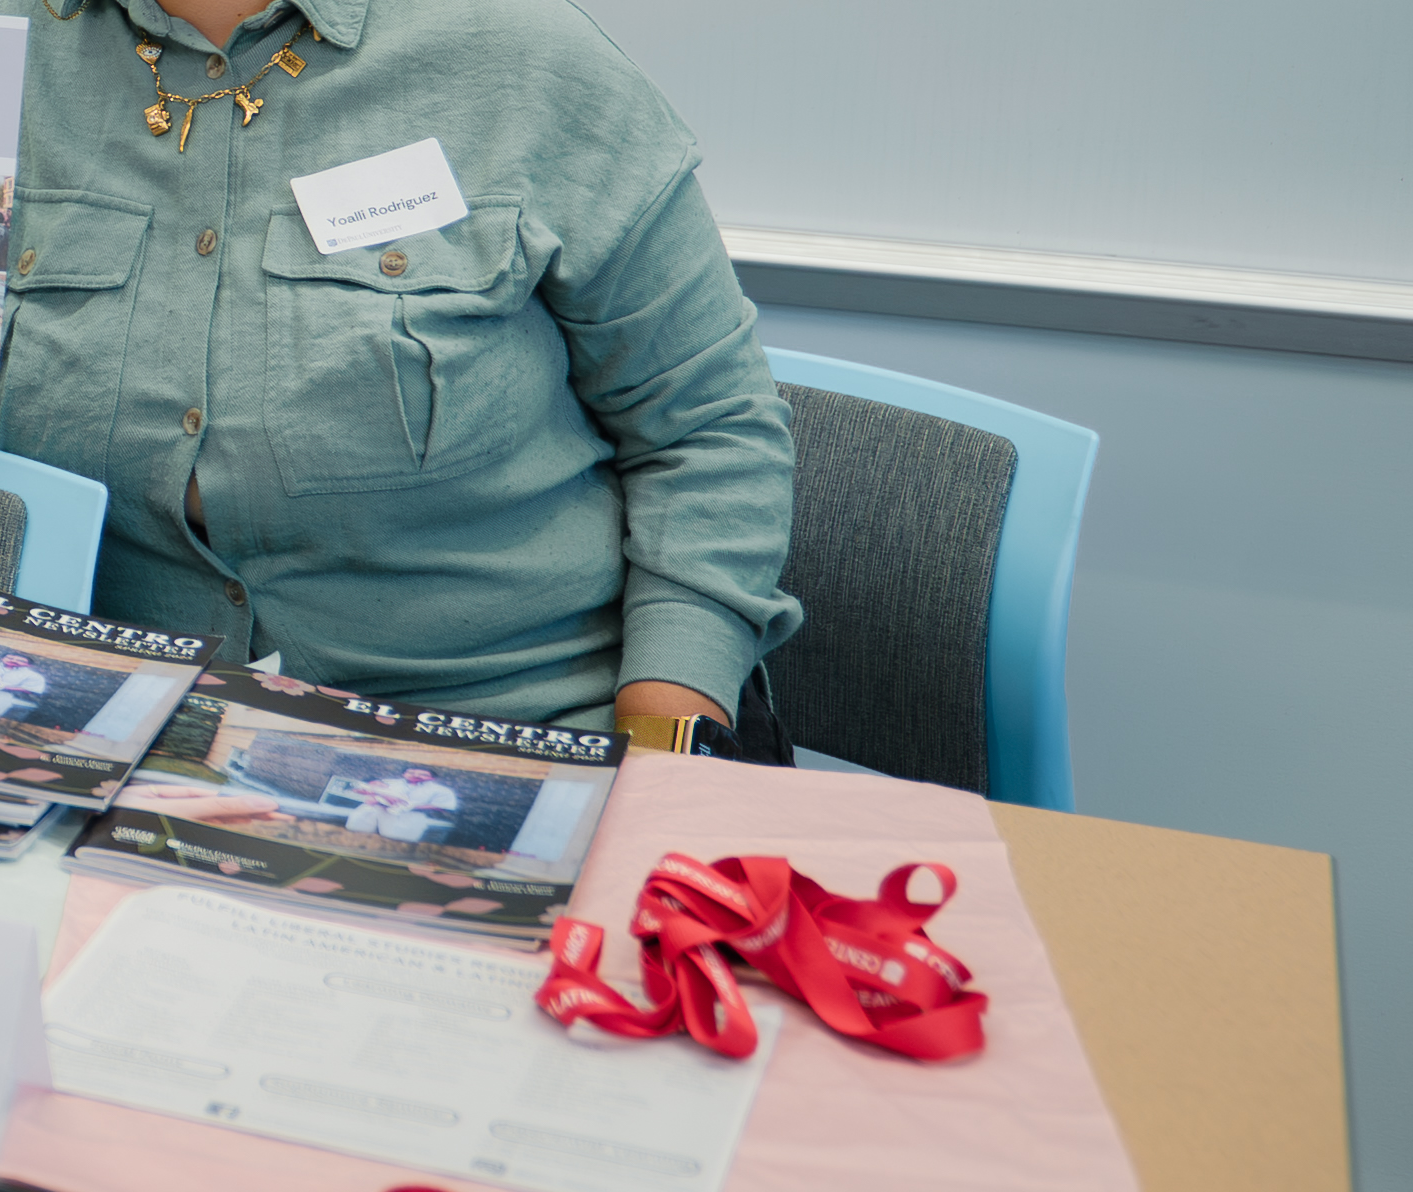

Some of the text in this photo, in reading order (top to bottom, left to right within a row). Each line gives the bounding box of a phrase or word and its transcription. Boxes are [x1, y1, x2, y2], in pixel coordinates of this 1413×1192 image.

[326, 191, 438, 228] Yoalli Rodriguez
[23, 615, 197, 657] NEWSLETTER
[29, 607, 203, 649] CENTRO
[343, 697, 611, 747] EL CENTRO
[413, 722, 607, 757] NEWSLETTER
[305, 937, 426, 972] AMERICAN
